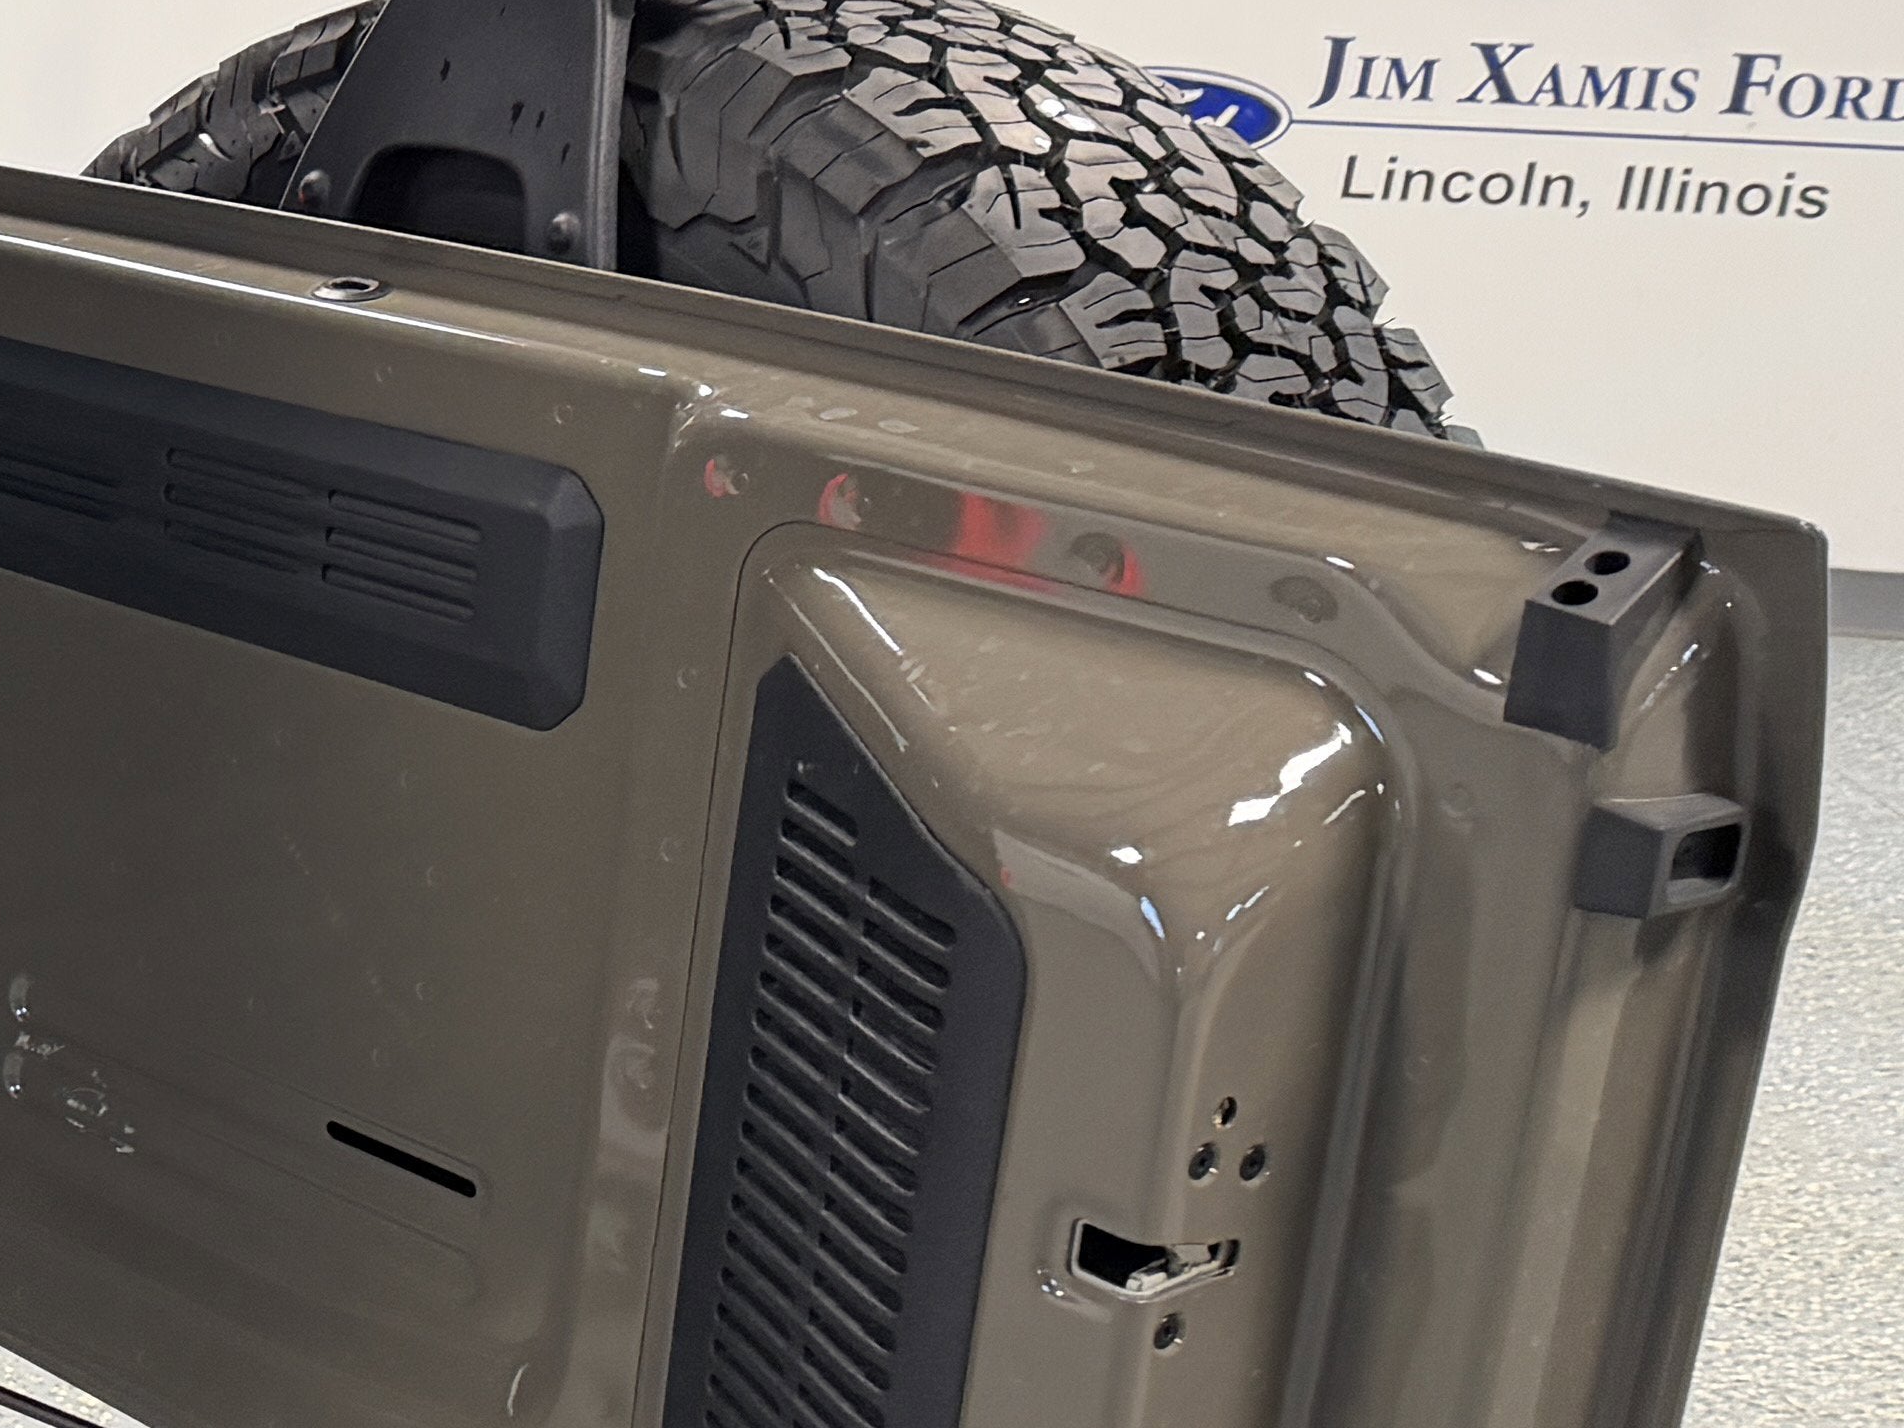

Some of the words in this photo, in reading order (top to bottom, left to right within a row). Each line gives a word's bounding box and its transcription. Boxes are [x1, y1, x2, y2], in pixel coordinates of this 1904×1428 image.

[1308, 35, 1441, 109] JIM
[1457, 42, 1700, 114] XAMIS
[1340, 155, 1591, 217] Lincoln,
[1616, 162, 1829, 219] Illinois
